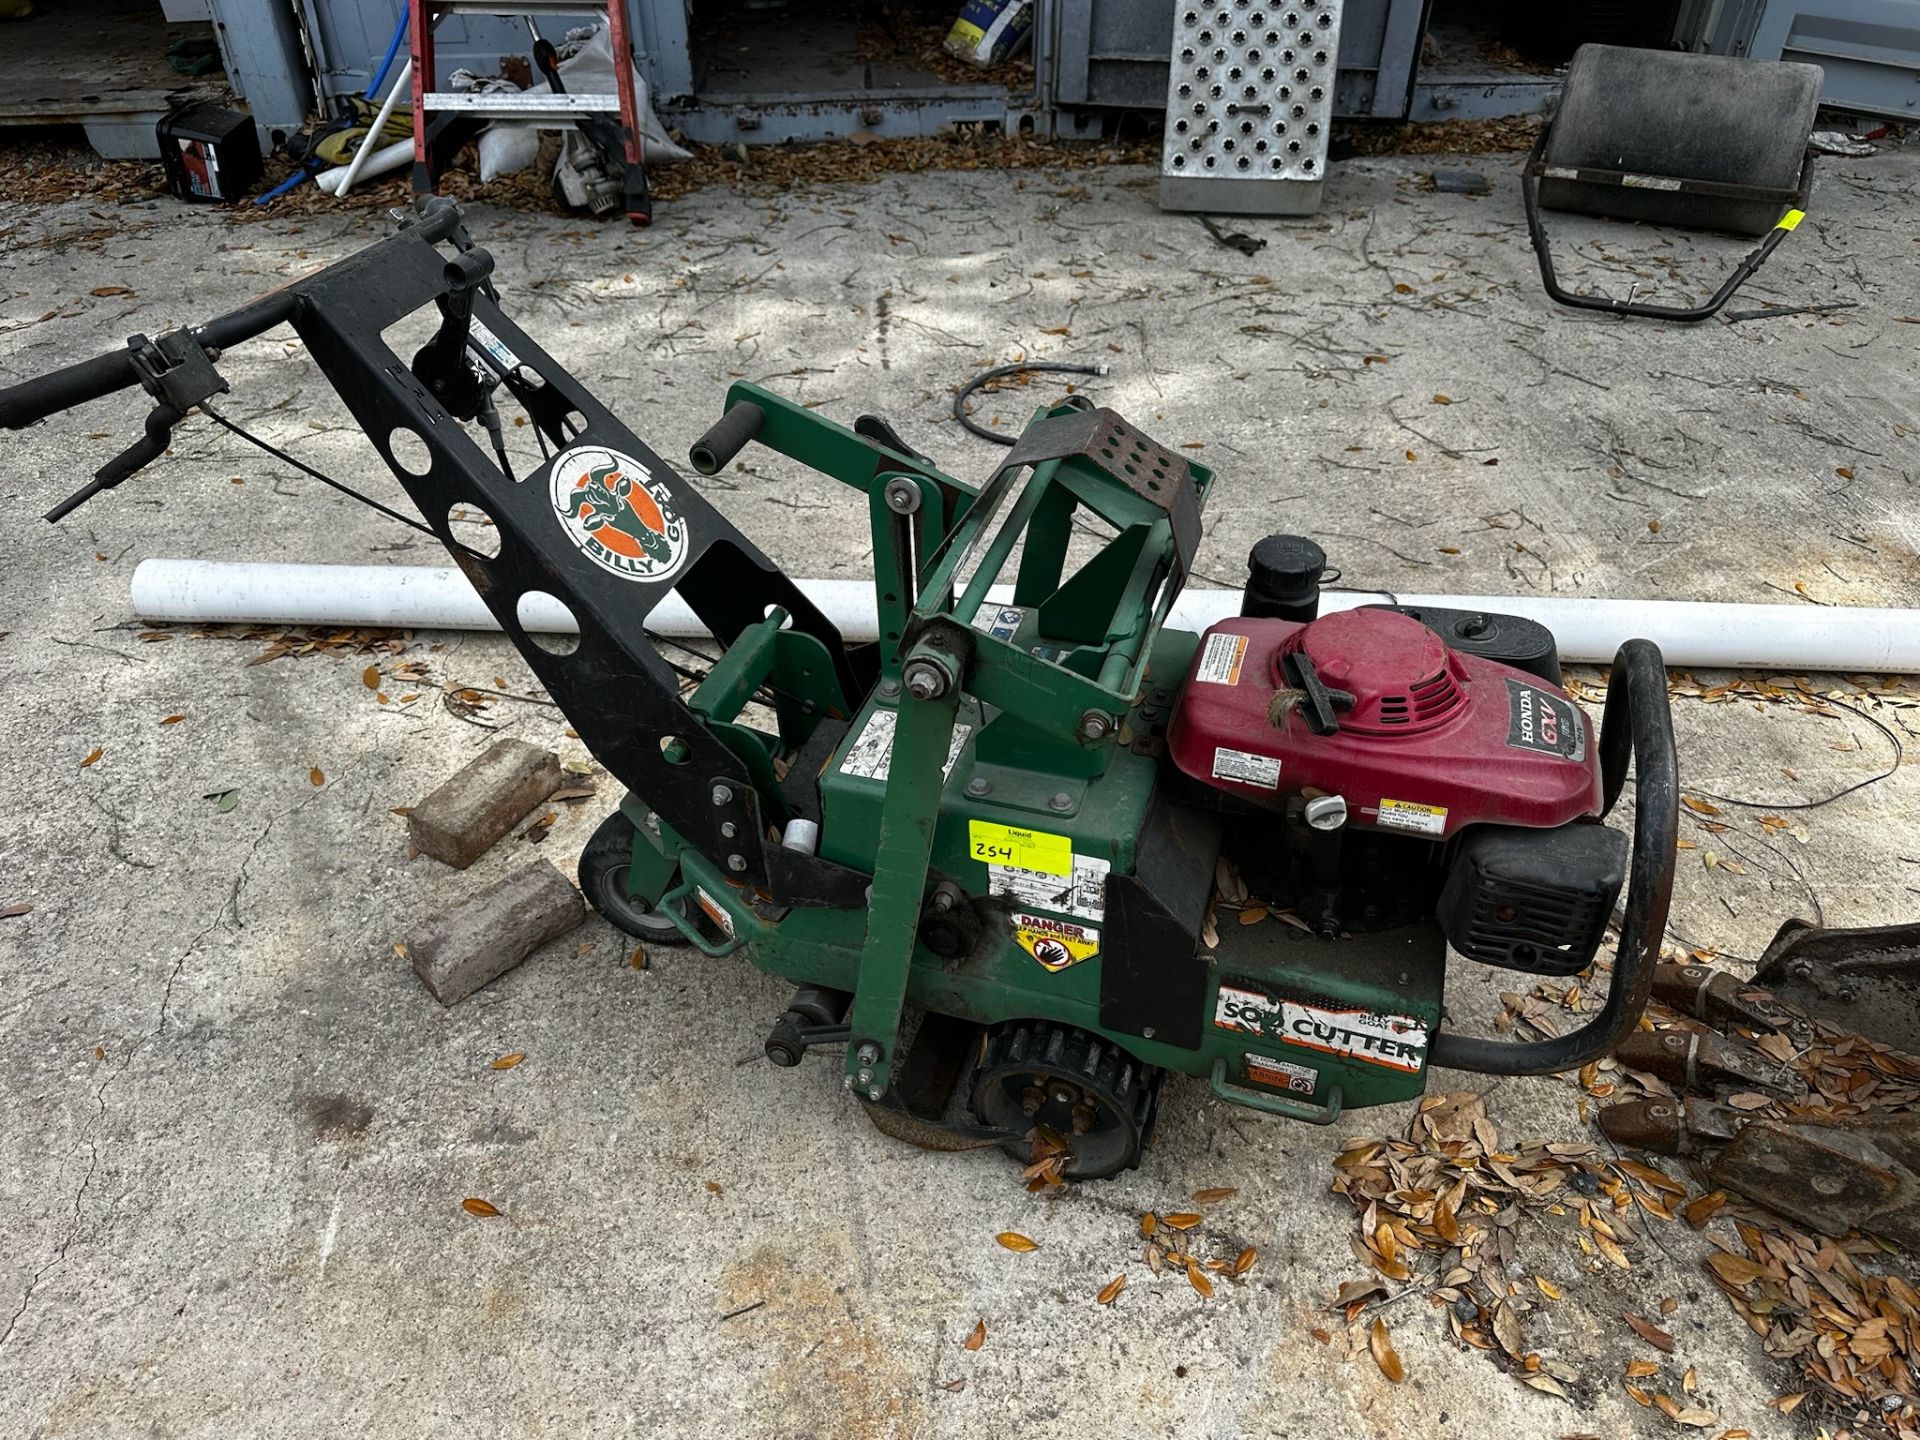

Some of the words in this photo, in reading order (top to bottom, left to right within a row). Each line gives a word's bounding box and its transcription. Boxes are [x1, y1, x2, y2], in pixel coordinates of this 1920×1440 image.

[585, 536, 653, 573] BILLY
[1520, 690, 1534, 744] HONDA
[1540, 697, 1558, 745] GXV
[1402, 804, 1432, 813] CAUTION
[1008, 828, 1032, 839] Liquid
[976, 842, 1013, 861] 254
[1021, 915, 1084, 939] DANGER
[1062, 935, 1077, 943] FEET
[1078, 938, 1095, 947] AWAY
[1359, 1013, 1391, 1025] BILLY
[1292, 1019, 1418, 1062] CUTTER
[1252, 1060, 1289, 1073] TRANSPORT
